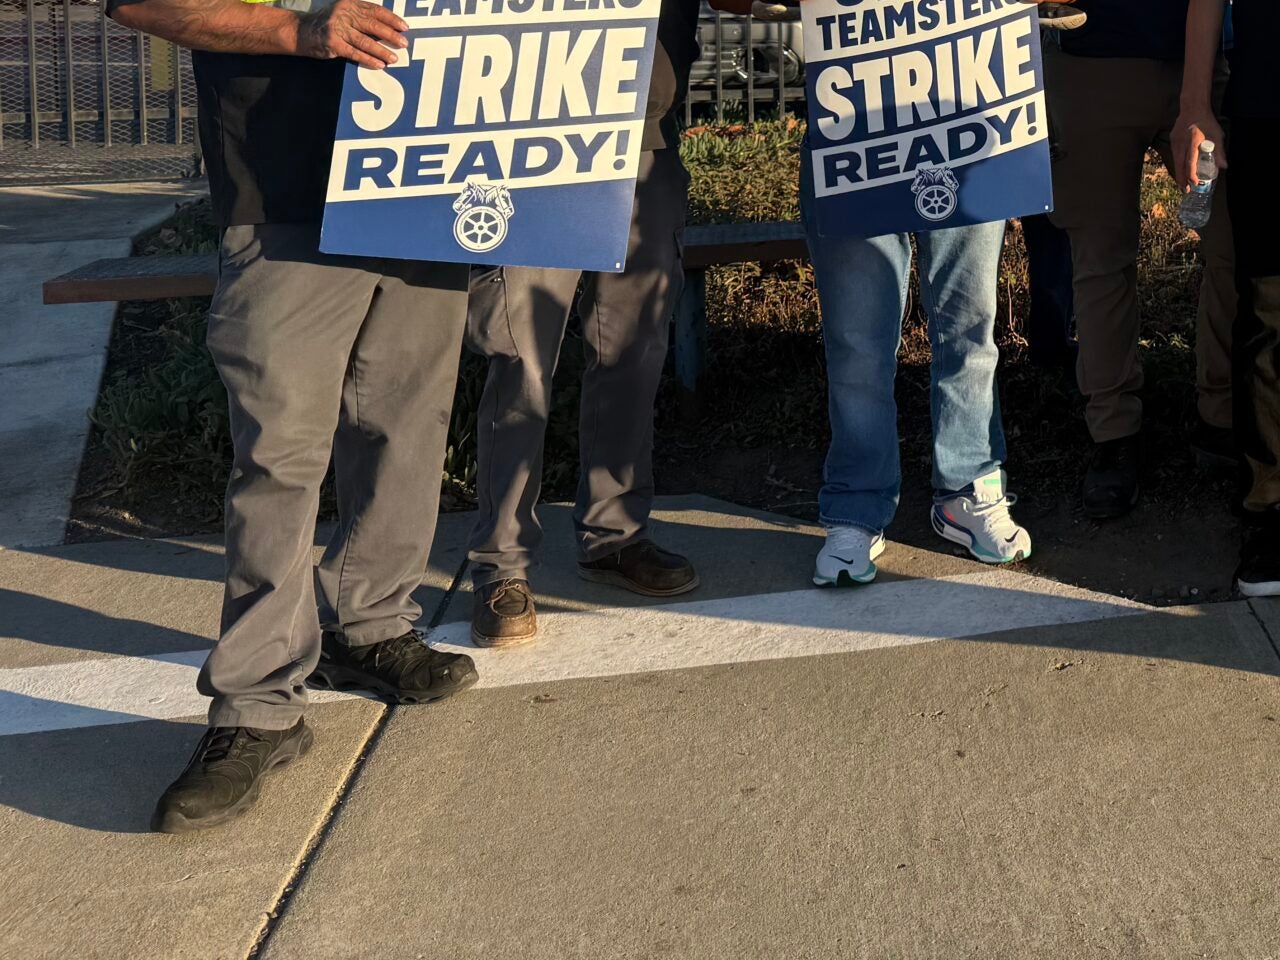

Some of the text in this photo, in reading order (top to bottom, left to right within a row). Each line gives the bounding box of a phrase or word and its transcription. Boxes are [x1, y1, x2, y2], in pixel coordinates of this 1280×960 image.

[351, 27, 646, 132] STRIKE
[815, 15, 1036, 141] STRIKE
[342, 129, 630, 192] READY!
[823, 101, 1037, 189] READY!
